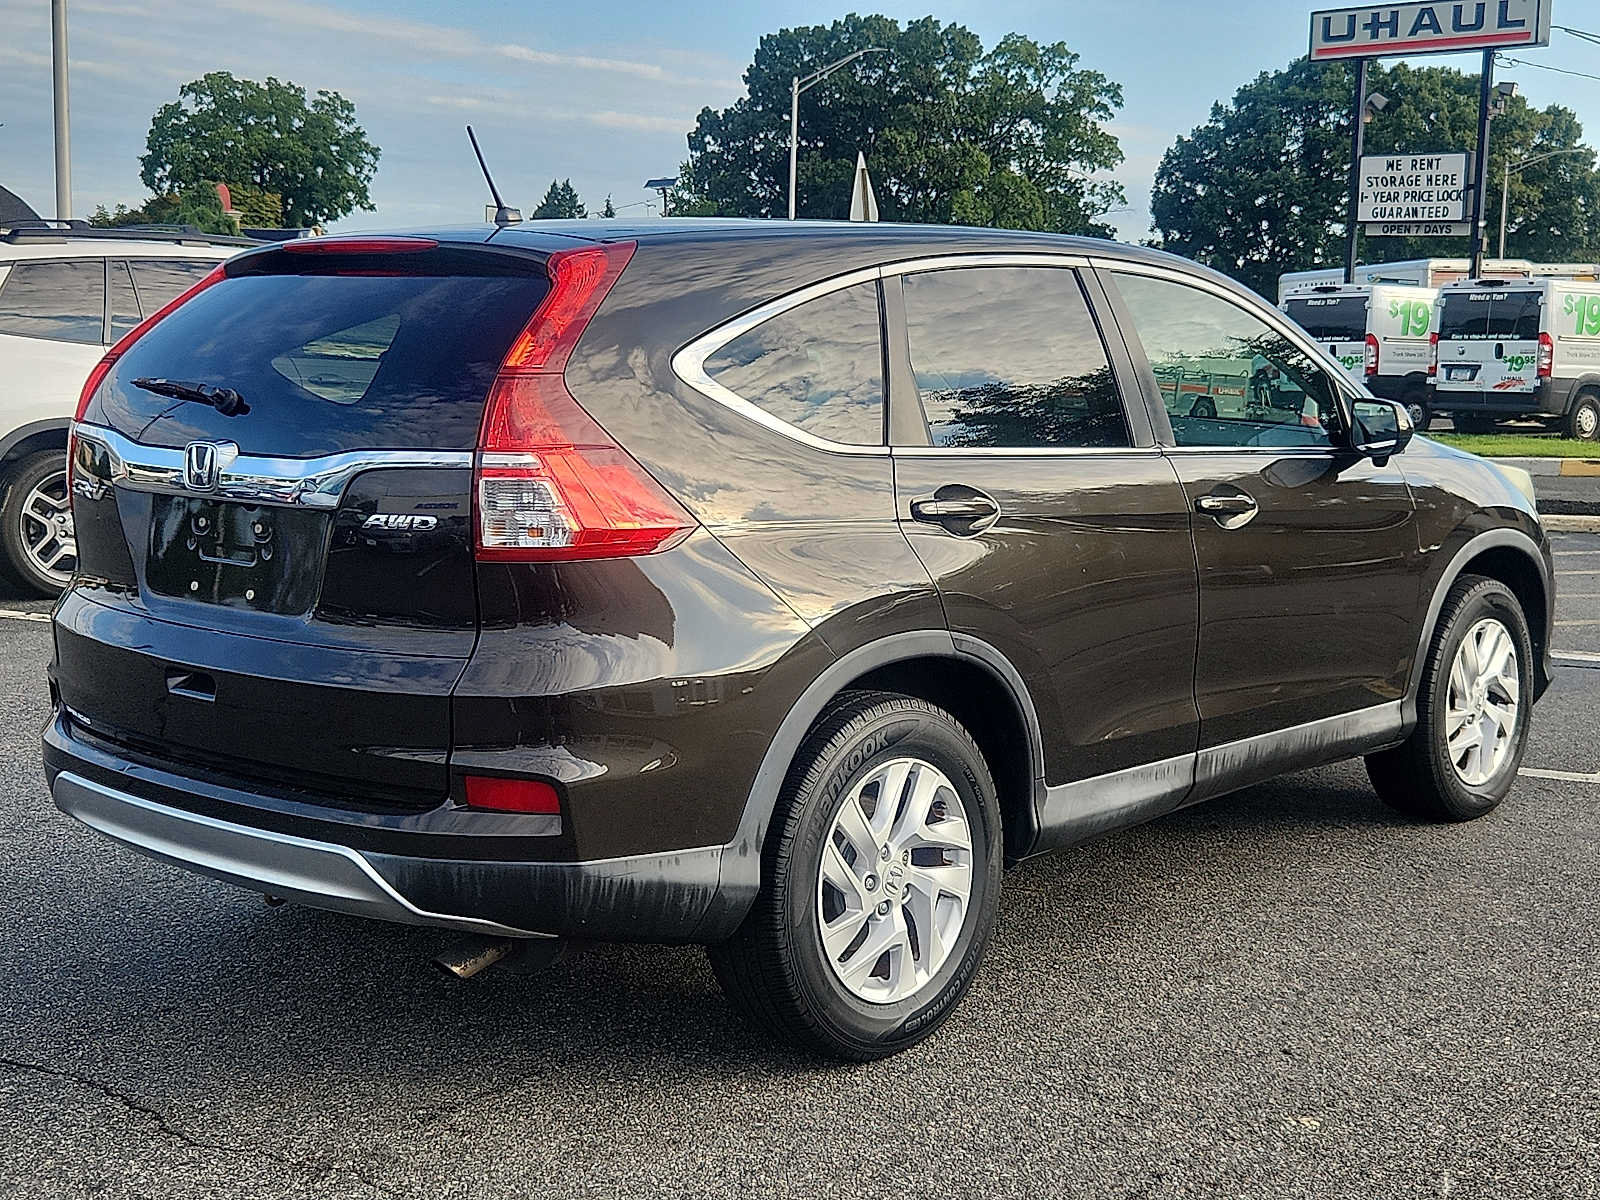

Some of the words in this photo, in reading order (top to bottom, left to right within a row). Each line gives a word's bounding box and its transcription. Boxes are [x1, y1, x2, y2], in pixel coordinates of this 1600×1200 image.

[1386, 160, 1402, 171] WE
[1411, 158, 1441, 170] RENT
[1366, 175, 1421, 187] STORAGE
[1426, 174, 1457, 186] HERE
[1373, 191, 1400, 203] YEAR
[1403, 190, 1434, 202] PRICE
[1437, 190, 1463, 201] LOCK
[1372, 206, 1449, 218] GUARANTEED
[1382, 225, 1410, 234] OPEN
[1415, 225, 1420, 233] 7
[1424, 225, 1452, 233] DAYS
[362, 514, 438, 531] AWD
